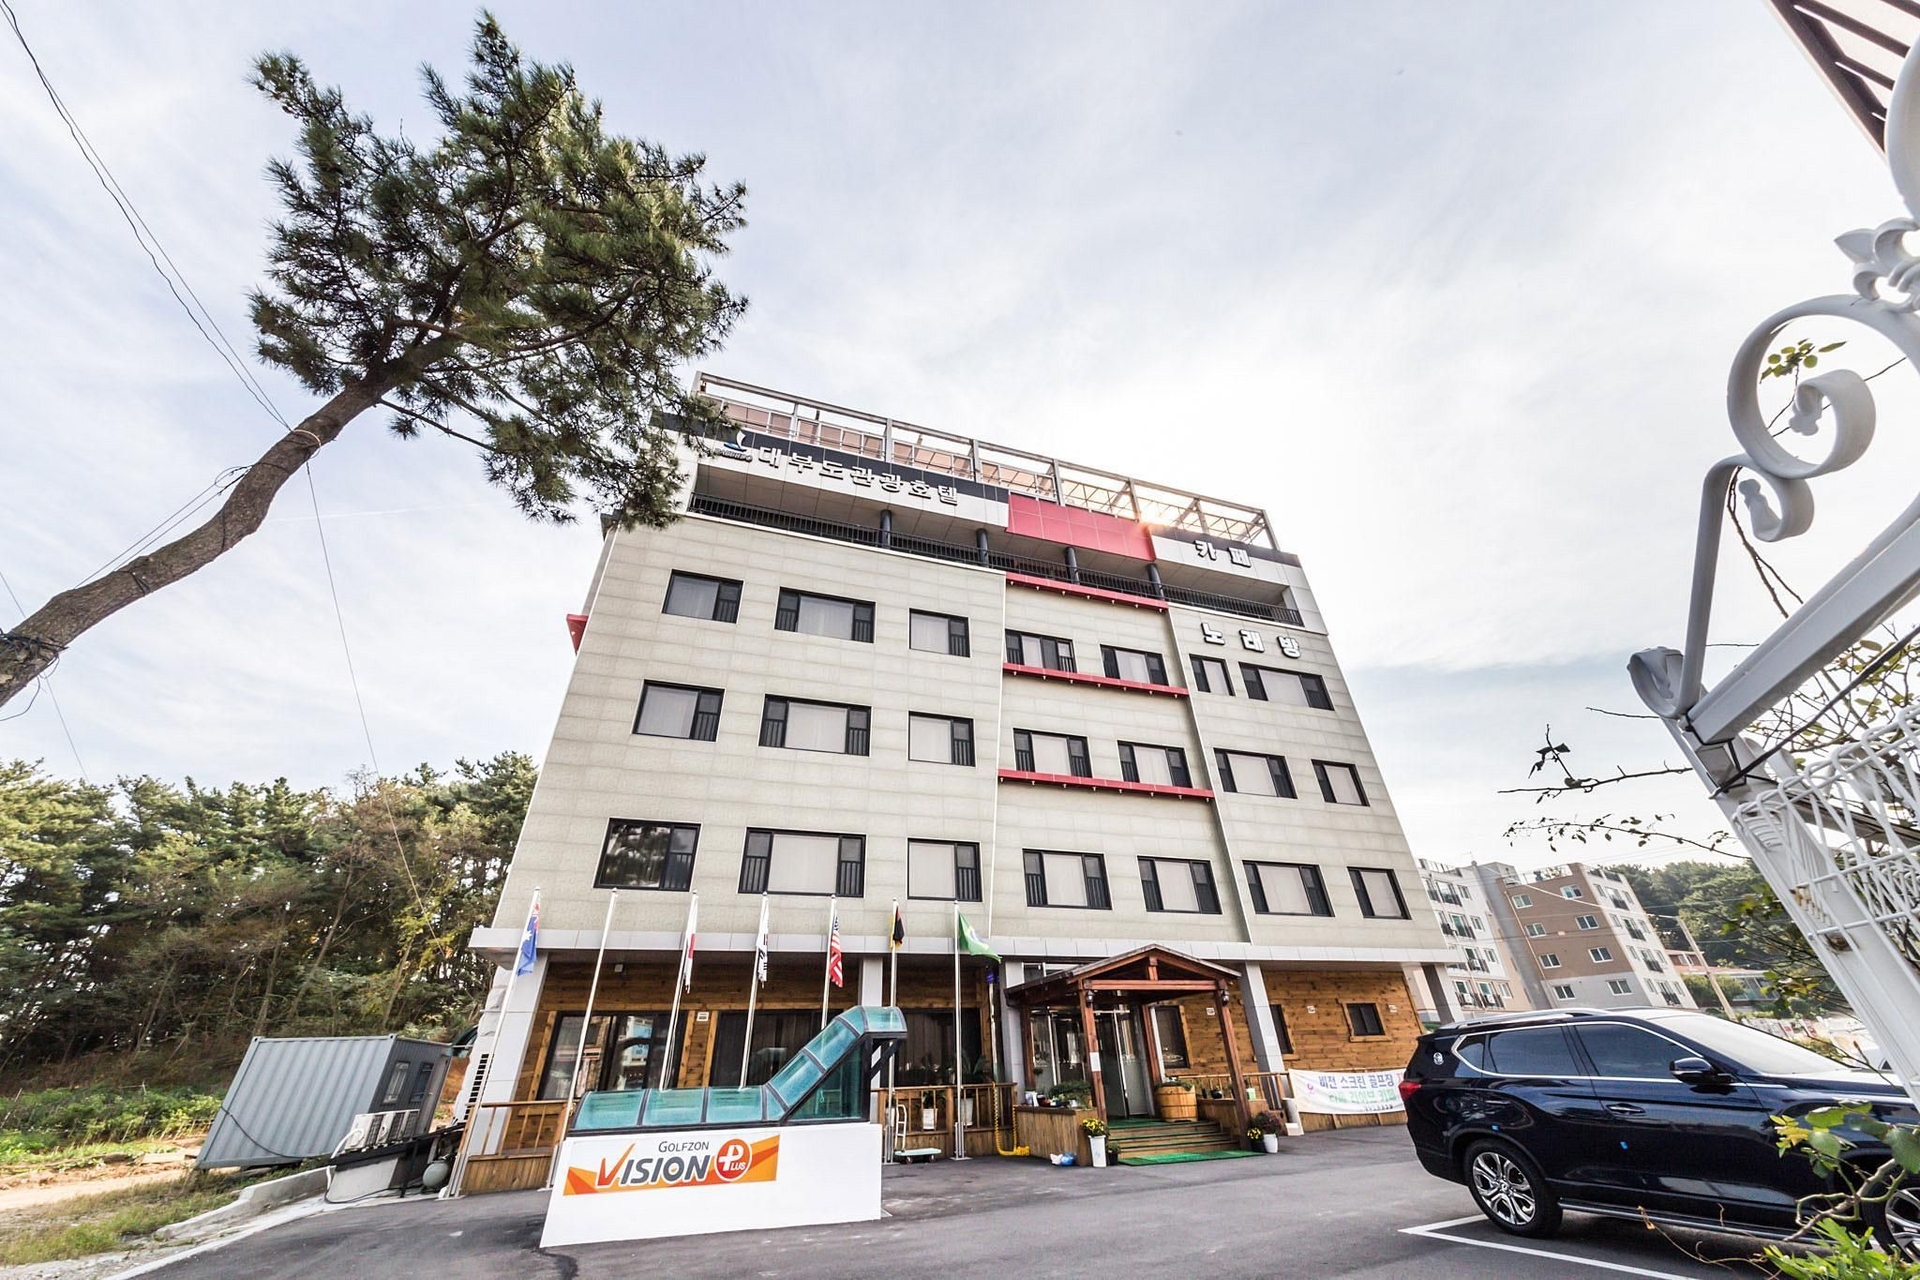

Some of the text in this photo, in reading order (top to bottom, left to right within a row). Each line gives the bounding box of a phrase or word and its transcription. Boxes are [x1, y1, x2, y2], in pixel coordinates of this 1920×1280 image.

[758, 446, 958, 505] 대부도관광호텔
[1201, 622, 1301, 658] 노래방
[1341, 1075, 1366, 1088] 스크린
[1368, 1074, 1394, 1088] 골프장
[598, 1143, 710, 1186] VISION
[658, 1140, 709, 1153] GOLFZON
